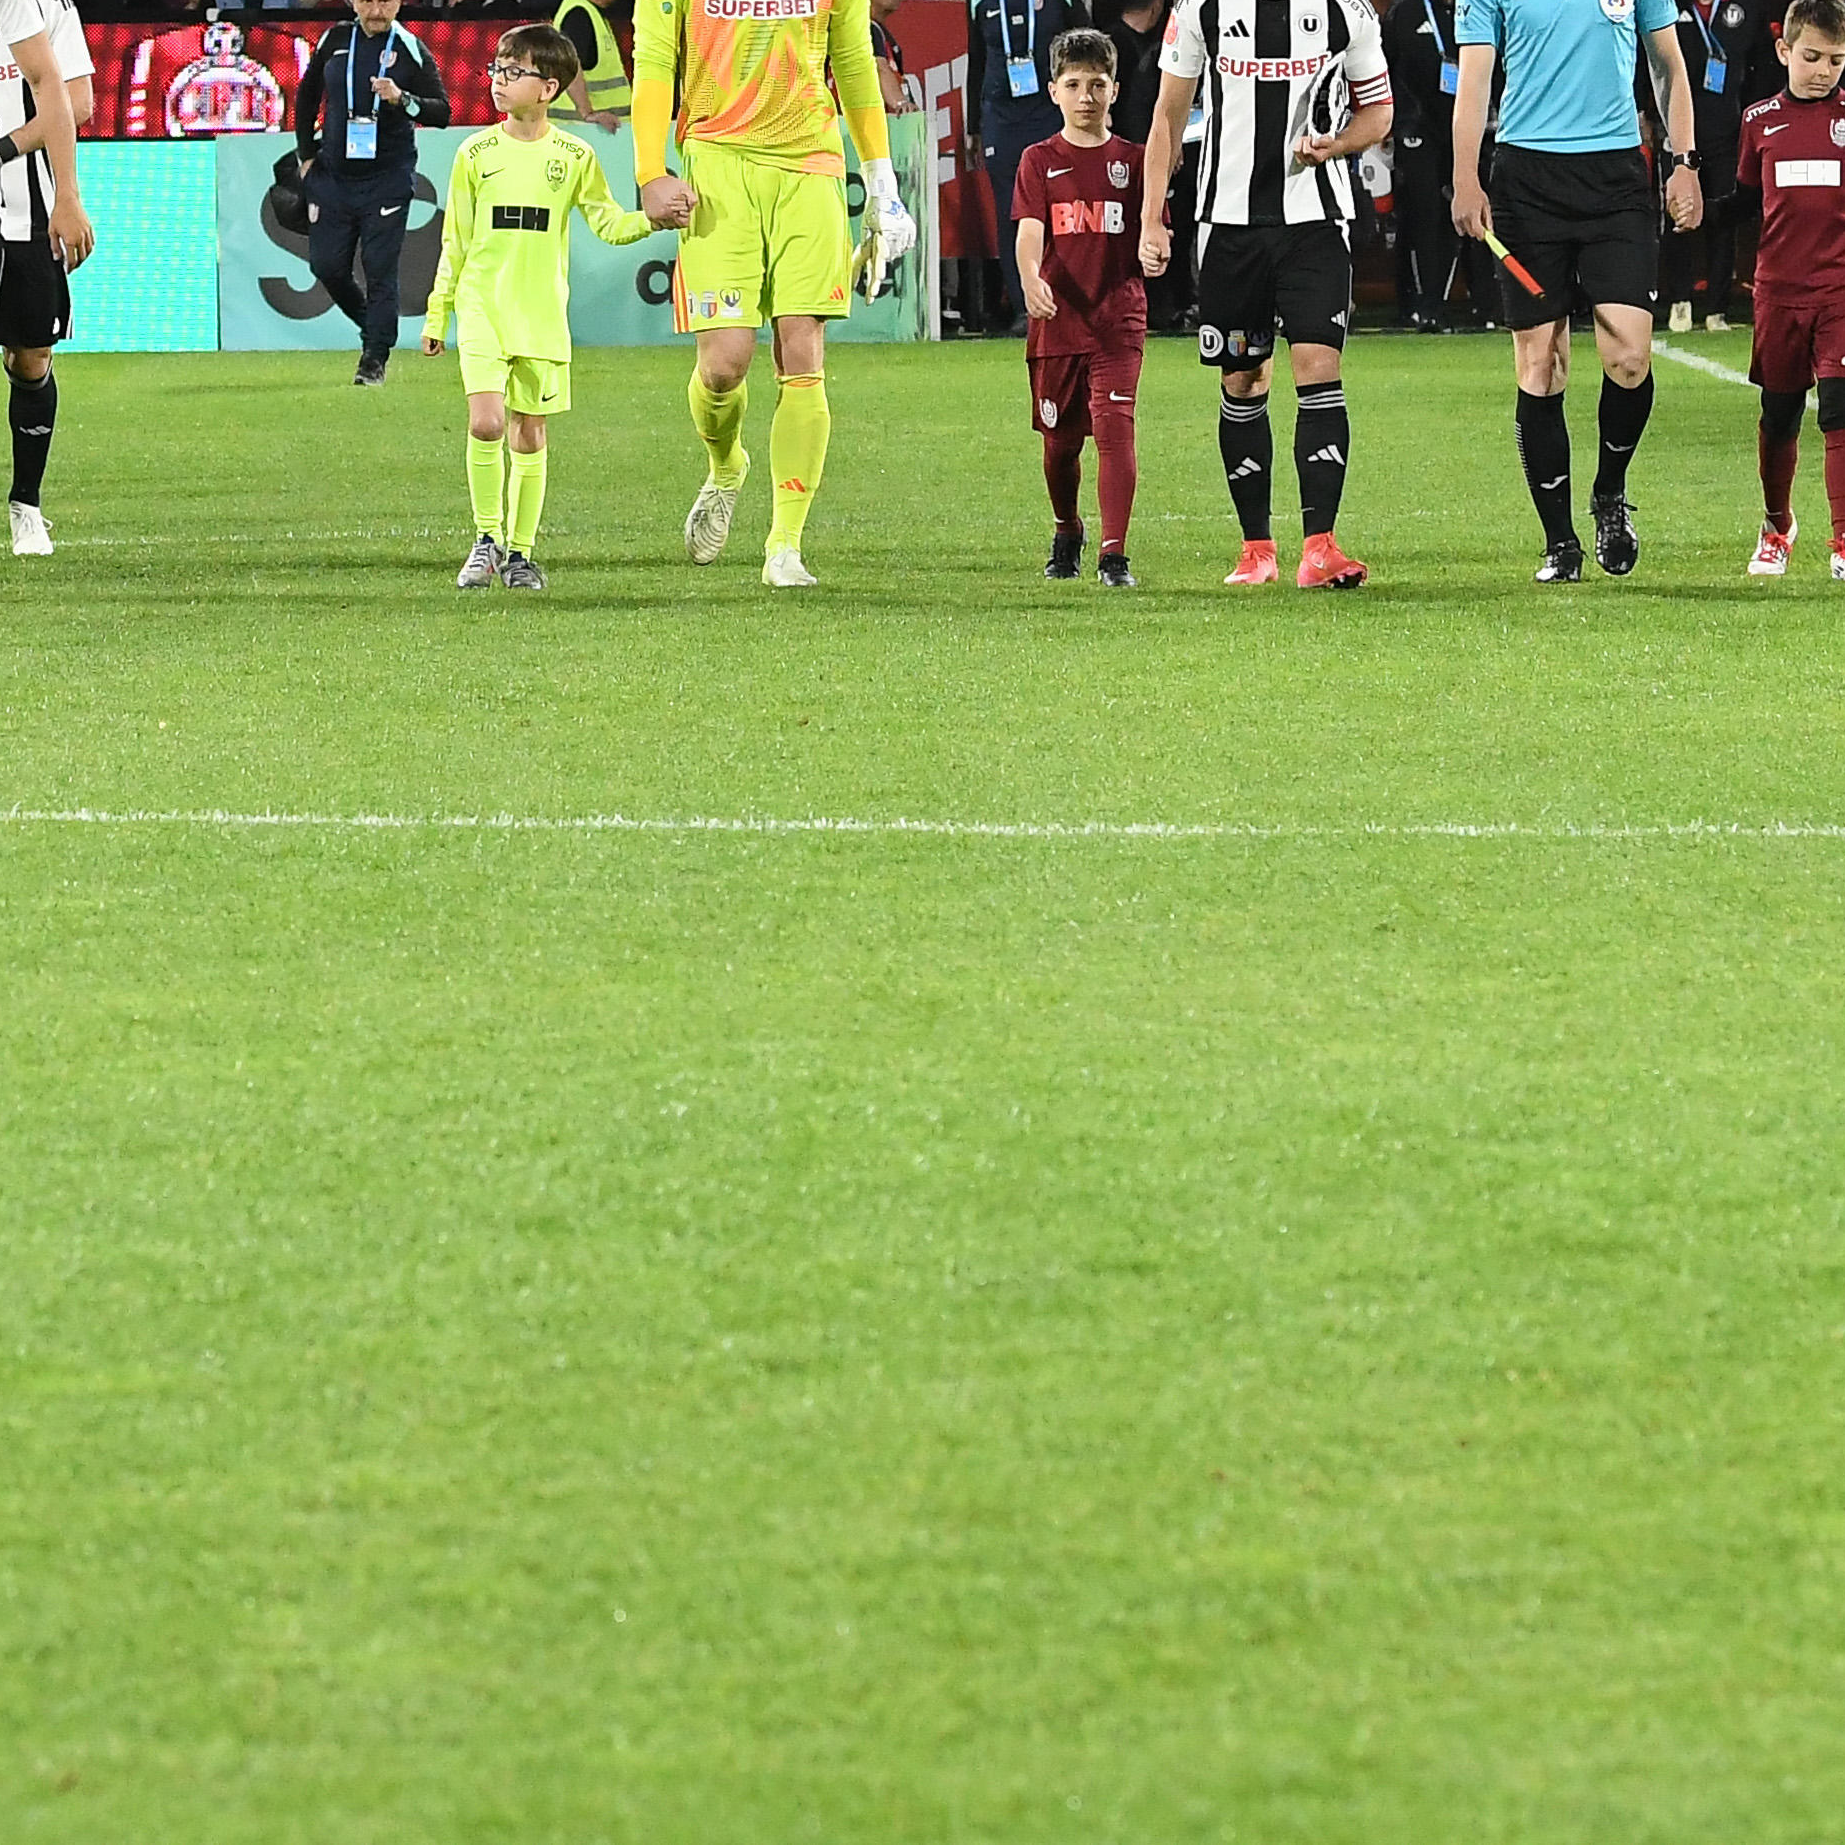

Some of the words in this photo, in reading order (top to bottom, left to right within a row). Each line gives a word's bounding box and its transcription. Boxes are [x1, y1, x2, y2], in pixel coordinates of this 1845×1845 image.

[1303, 17, 1319, 32] U
[1218, 53, 1330, 79] SUPERBET
[1744, 98, 1782, 124] .msg
[468, 135, 499, 161] .msg
[552, 137, 586, 159] .msg
[1051, 200, 1126, 236] BNB
